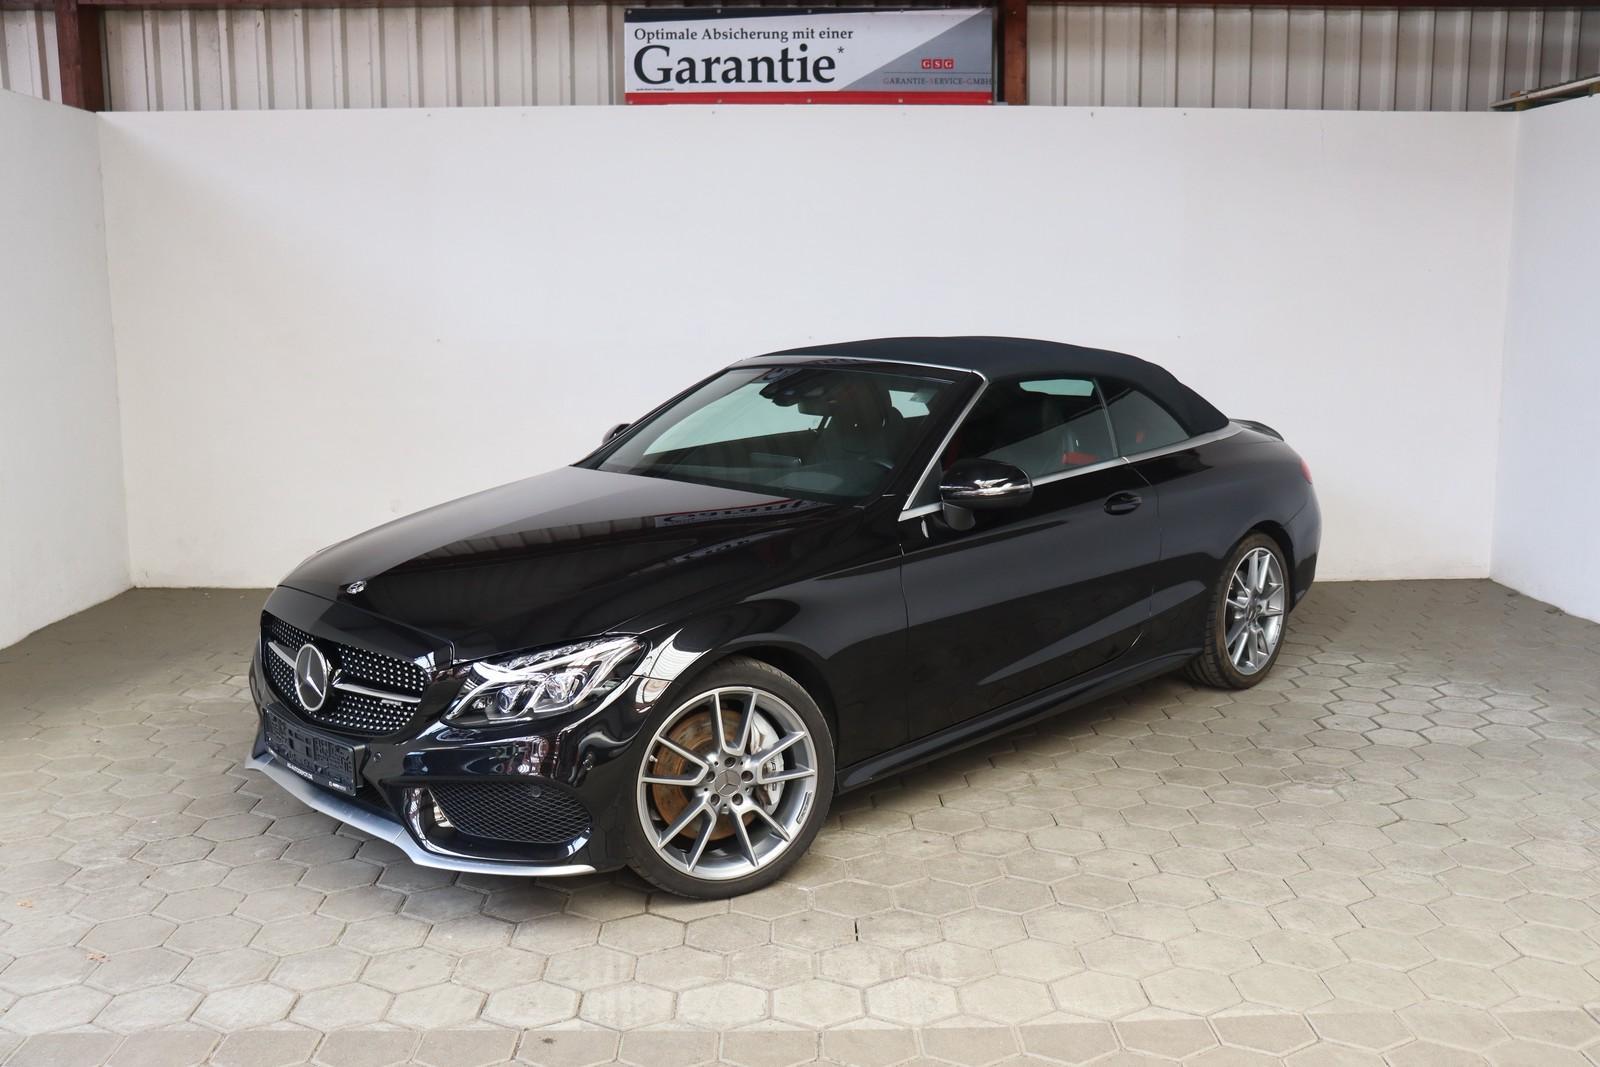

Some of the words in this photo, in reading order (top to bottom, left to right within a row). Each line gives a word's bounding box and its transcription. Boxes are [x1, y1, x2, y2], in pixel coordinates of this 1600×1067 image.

[634, 28, 697, 44] Optimale
[702, 28, 789, 43] Absicherung
[792, 27, 815, 40] mit
[818, 27, 854, 40] einer
[921, 59, 954, 69] GSG
